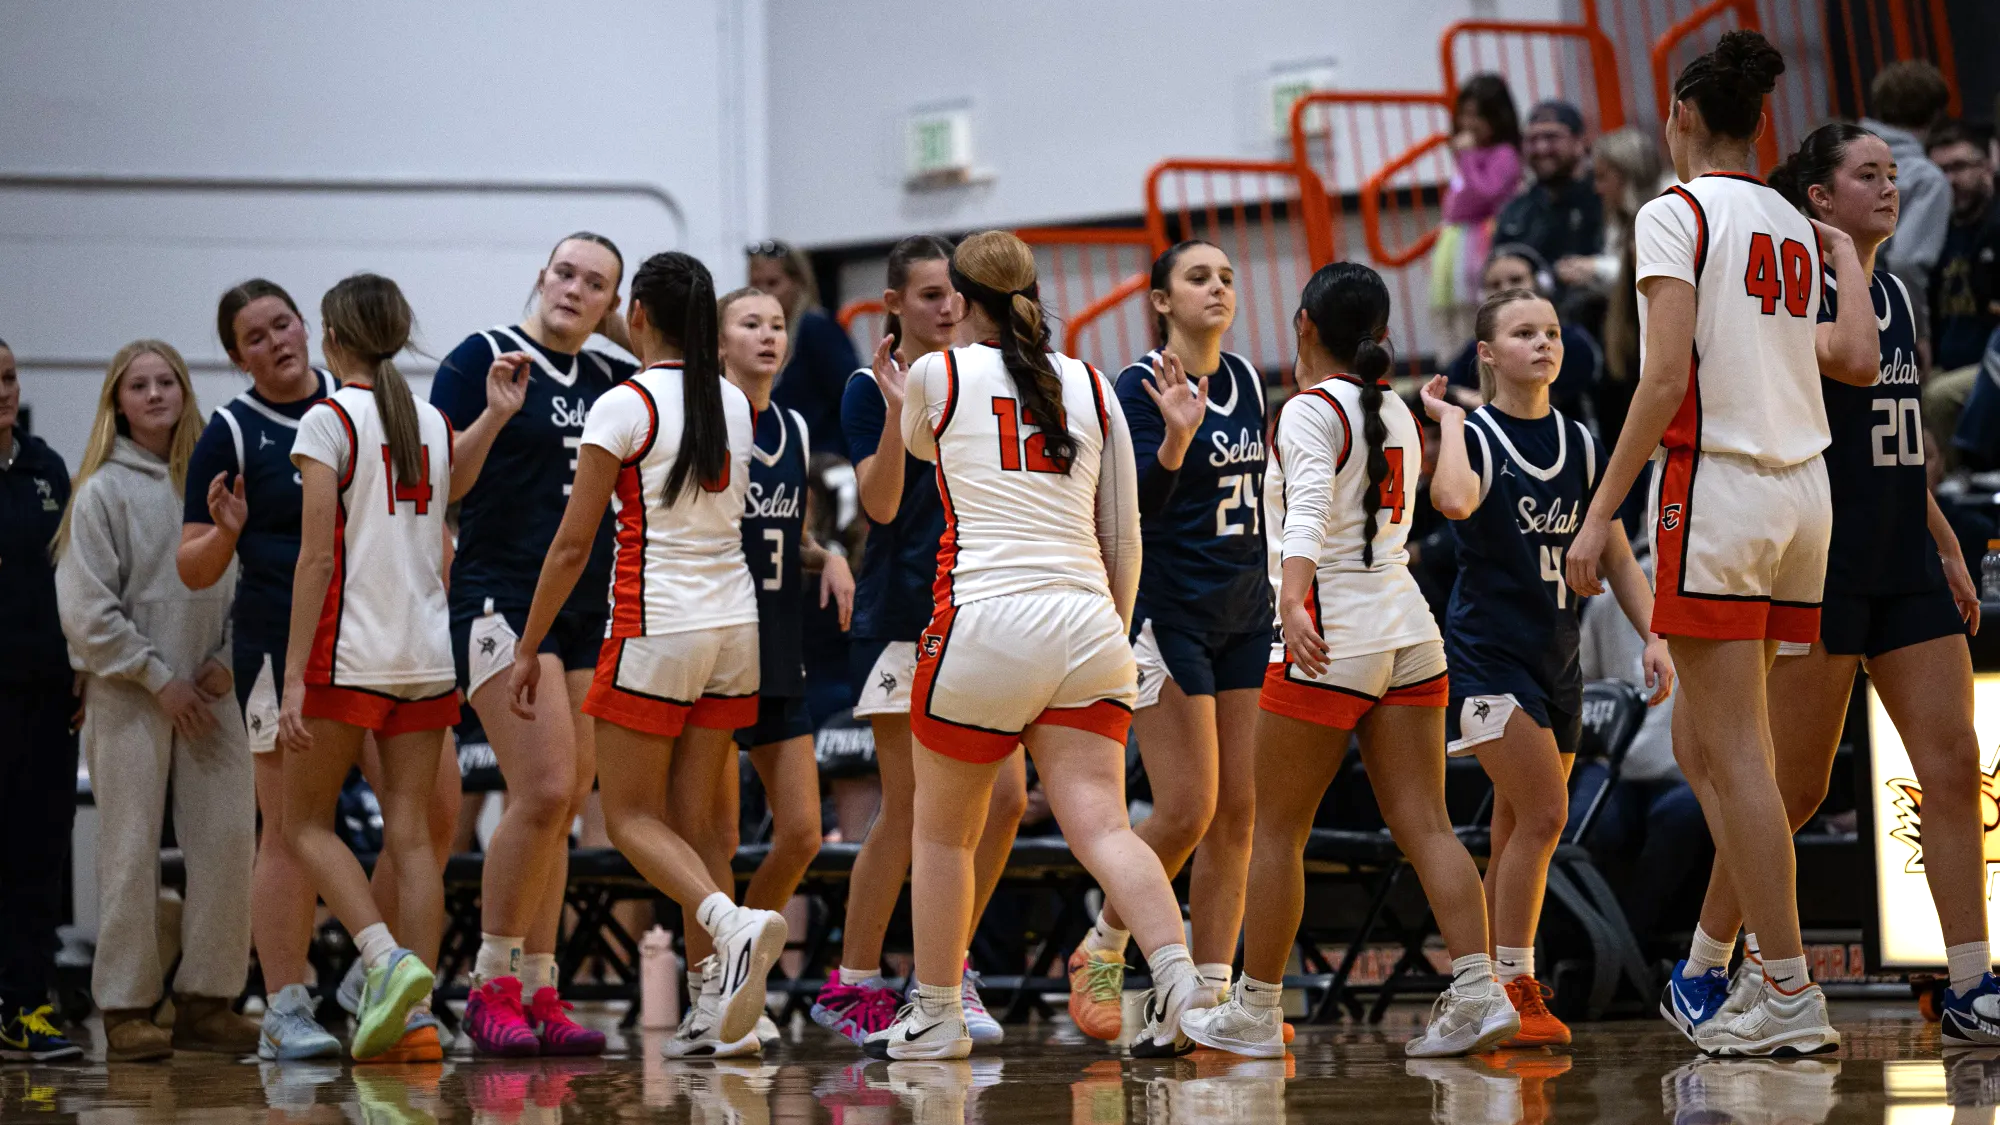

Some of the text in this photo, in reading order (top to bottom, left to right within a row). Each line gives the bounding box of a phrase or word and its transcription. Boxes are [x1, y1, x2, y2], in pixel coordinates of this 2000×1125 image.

[1744, 232, 1812, 317] 40
[1872, 346, 1920, 386] elah
[551, 396, 590, 427] Sel
[1871, 398, 1924, 466] 20
[1209, 427, 1264, 467] Selah
[744, 482, 799, 518] Selah
[1216, 473, 1262, 536] 24
[1380, 447, 1405, 524] 4
[1516, 496, 1579, 534] Selah
[763, 528, 784, 591] 3
[1540, 545, 1567, 609] 4
